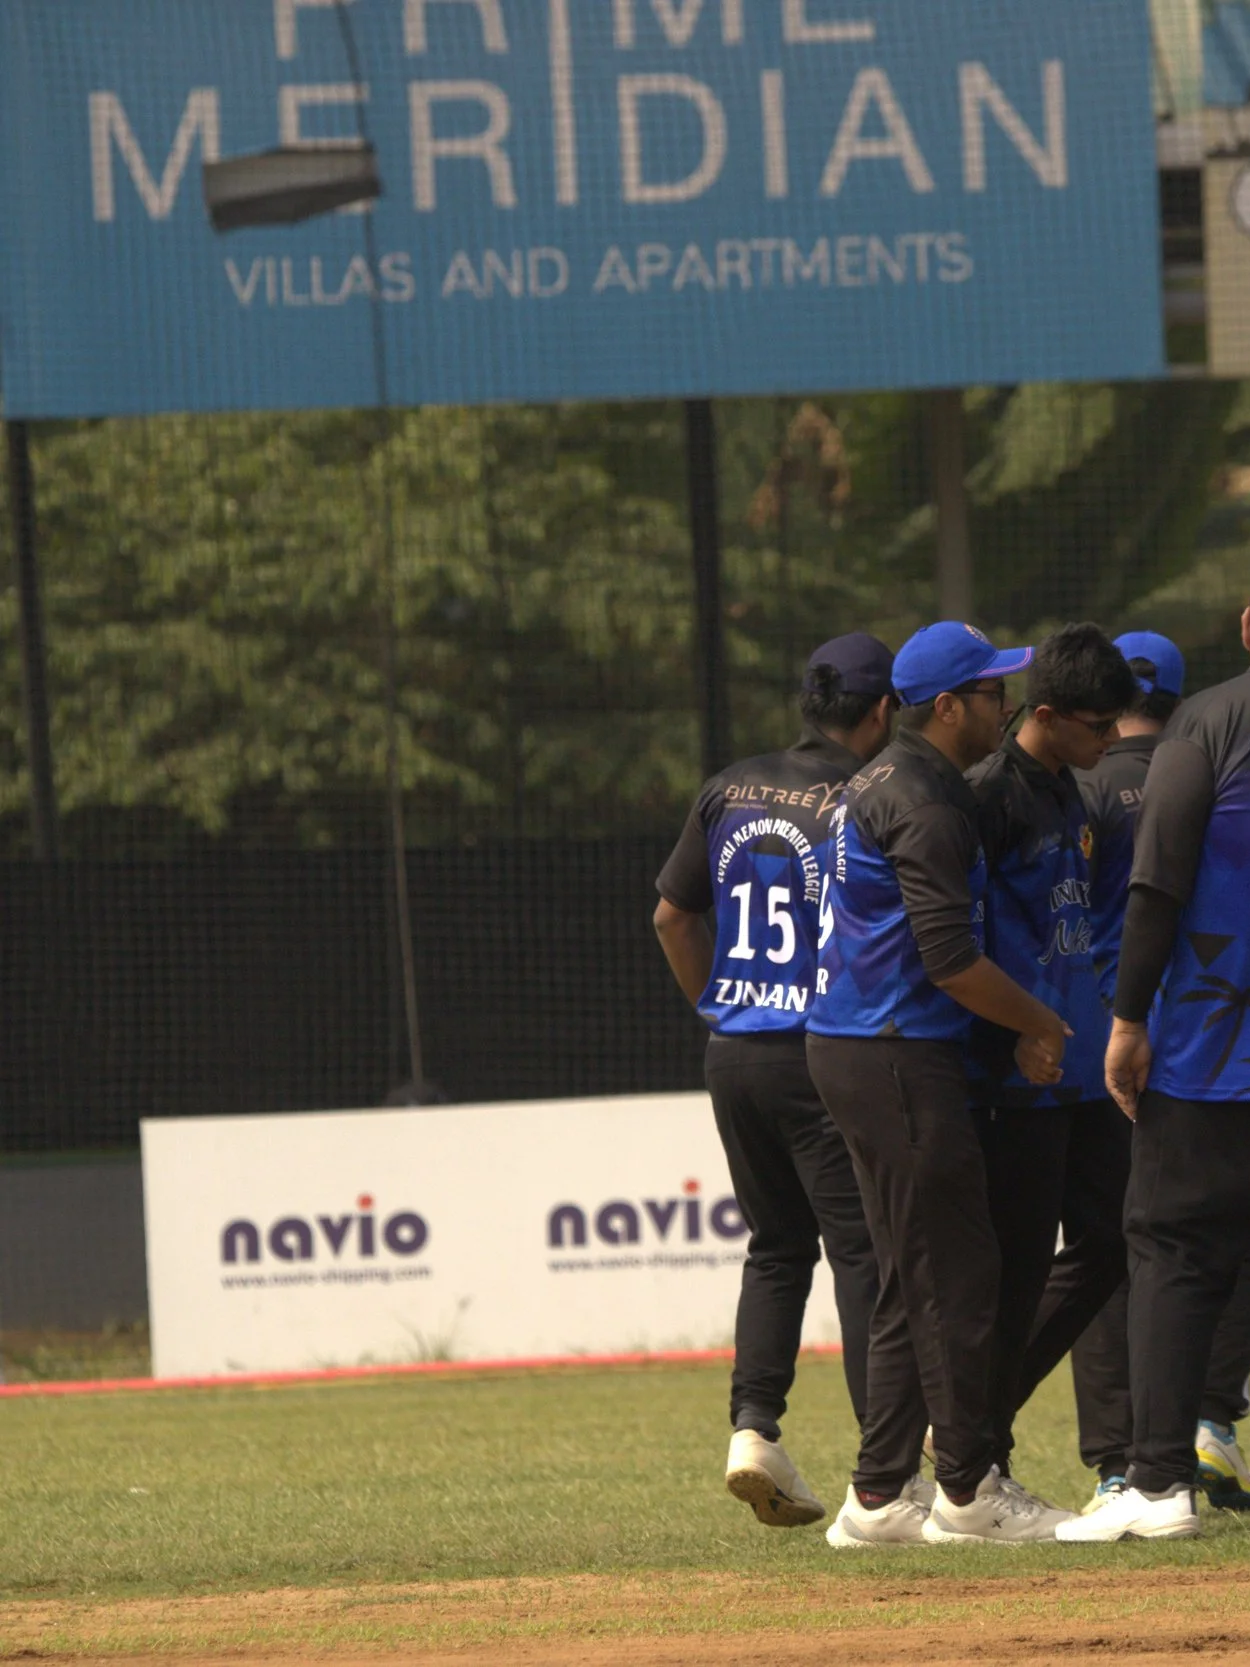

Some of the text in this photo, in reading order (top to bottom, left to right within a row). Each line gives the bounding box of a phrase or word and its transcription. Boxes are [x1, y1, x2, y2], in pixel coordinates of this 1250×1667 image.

[88, 58, 1069, 222] MERIDIAN
[226, 232, 975, 306] VILLAS AND APARTMENTS
[725, 784, 817, 808] BILTREE
[717, 839, 737, 884] CUTCHI
[732, 817, 773, 848] MEMON
[772, 817, 812, 858] PREMIER
[801, 855, 820, 905] LEAGUE
[727, 881, 796, 965] 15
[714, 977, 809, 1013] ZINAN
[220, 1193, 429, 1264] navio
[547, 1177, 749, 1248] navio
